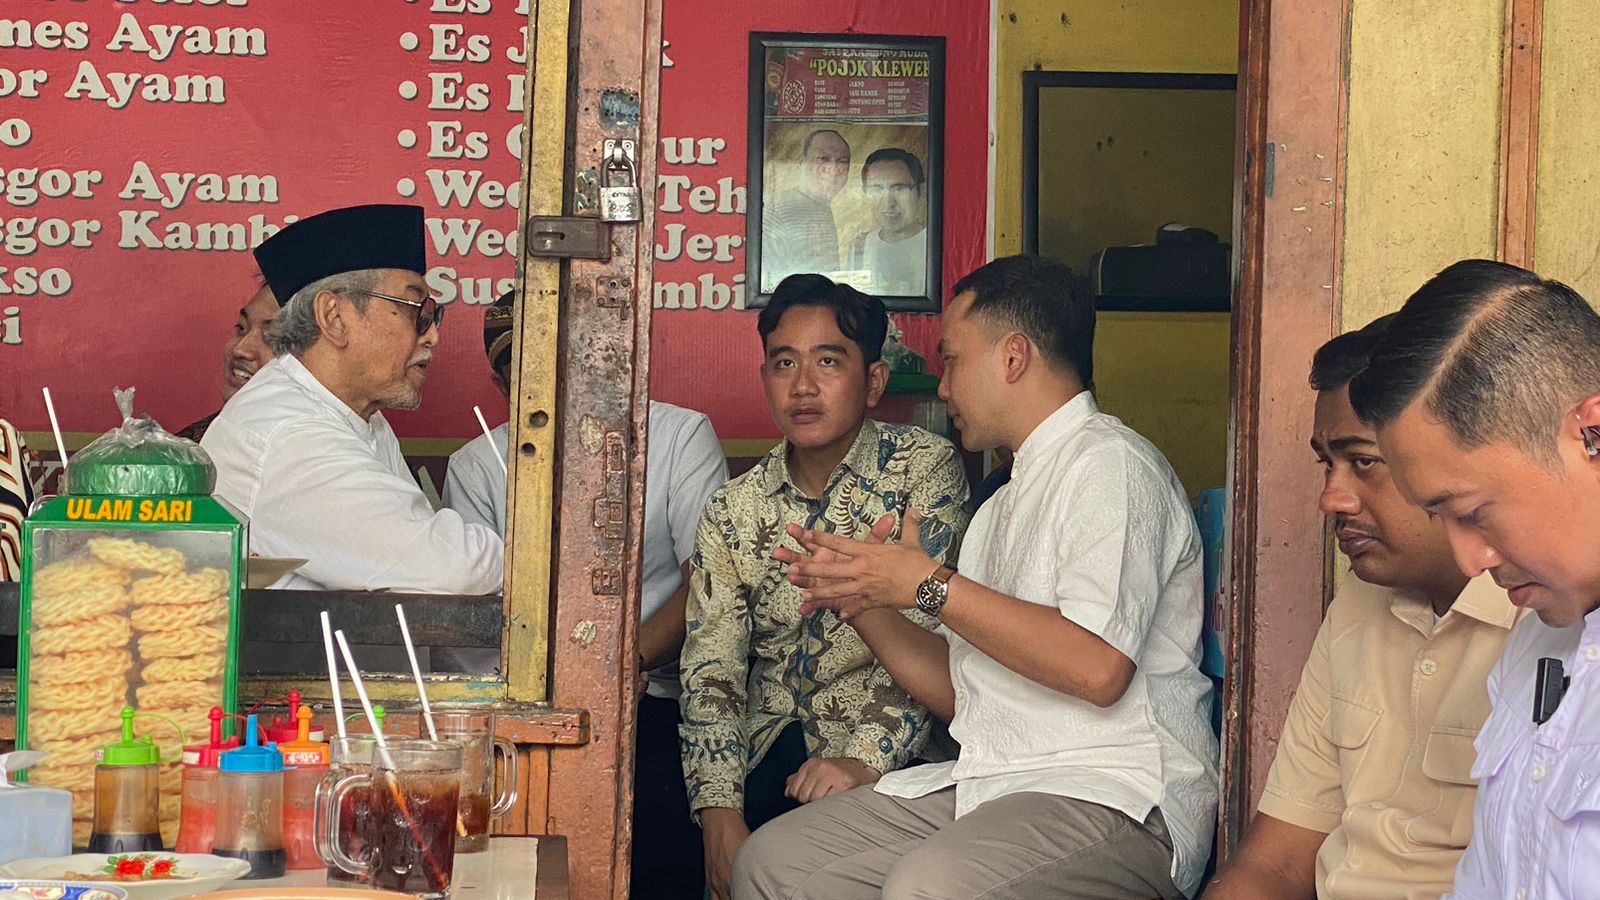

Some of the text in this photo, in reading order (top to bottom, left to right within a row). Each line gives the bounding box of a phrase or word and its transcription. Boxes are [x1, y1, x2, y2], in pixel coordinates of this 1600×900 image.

[106, 13, 267, 61] Ayam
[428, 23, 491, 62] Es
[64, 60, 226, 108] Ayam
[427, 72, 490, 110] Es
[426, 120, 489, 159] Es
[0, 161, 279, 209] gor Ayam
[657, 174, 747, 214] Teh
[0, 210, 300, 255] gor Kamb
[67, 498, 193, 522] ULAM SARI
